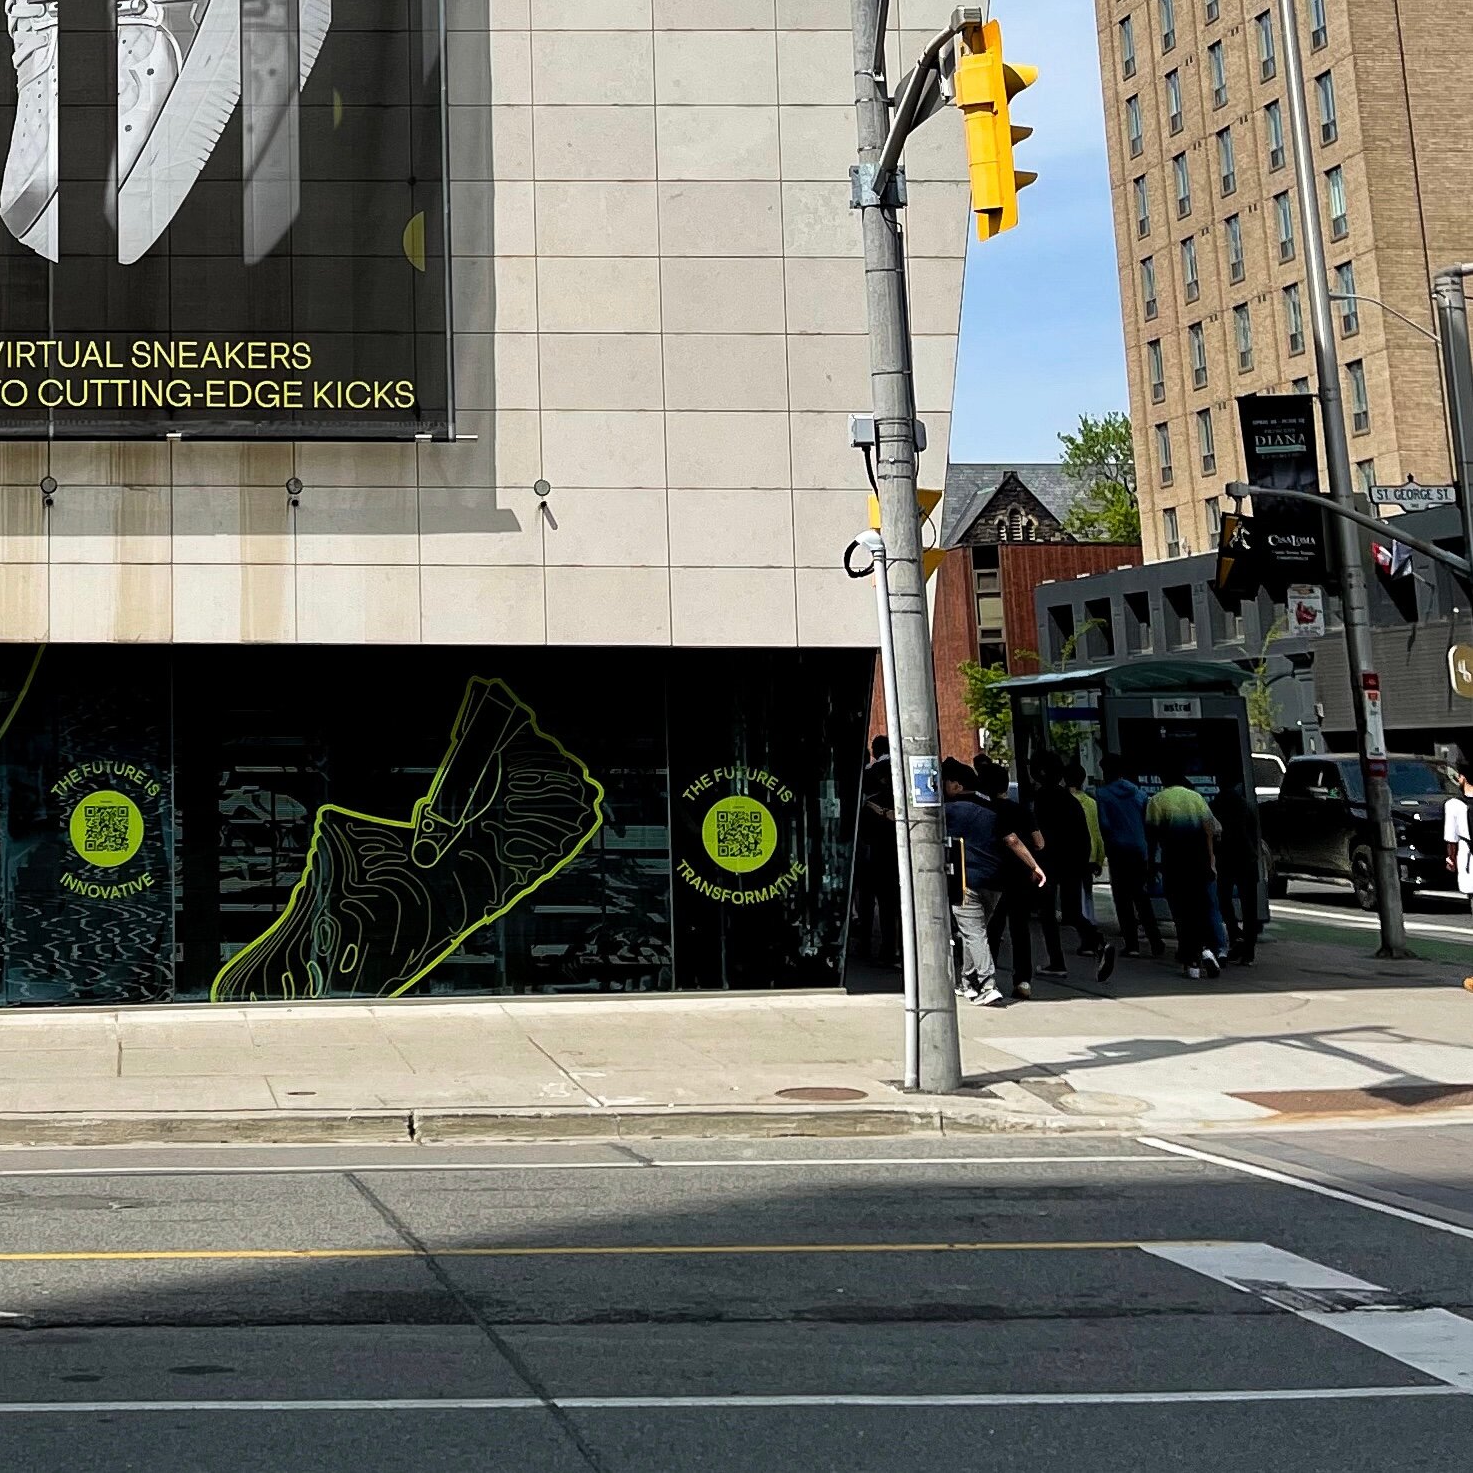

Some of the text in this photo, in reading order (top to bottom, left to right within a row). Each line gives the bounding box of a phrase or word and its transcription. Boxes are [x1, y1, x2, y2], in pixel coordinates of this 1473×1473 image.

[131, 340, 312, 370] SNEAKERS
[37, 379, 304, 408] CUTTING-EDGE
[313, 380, 415, 409] KICKS
[1254, 432, 1306, 446] DIANA
[1393, 489, 1433, 501] GEORGE
[51, 760, 161, 796] THE FUTURE IS
[682, 773, 714, 801] THE
[776, 785, 793, 803] IS
[59, 872, 155, 899] INNOVATIVE
[676, 858, 807, 905] TRANSFORMATIVE
